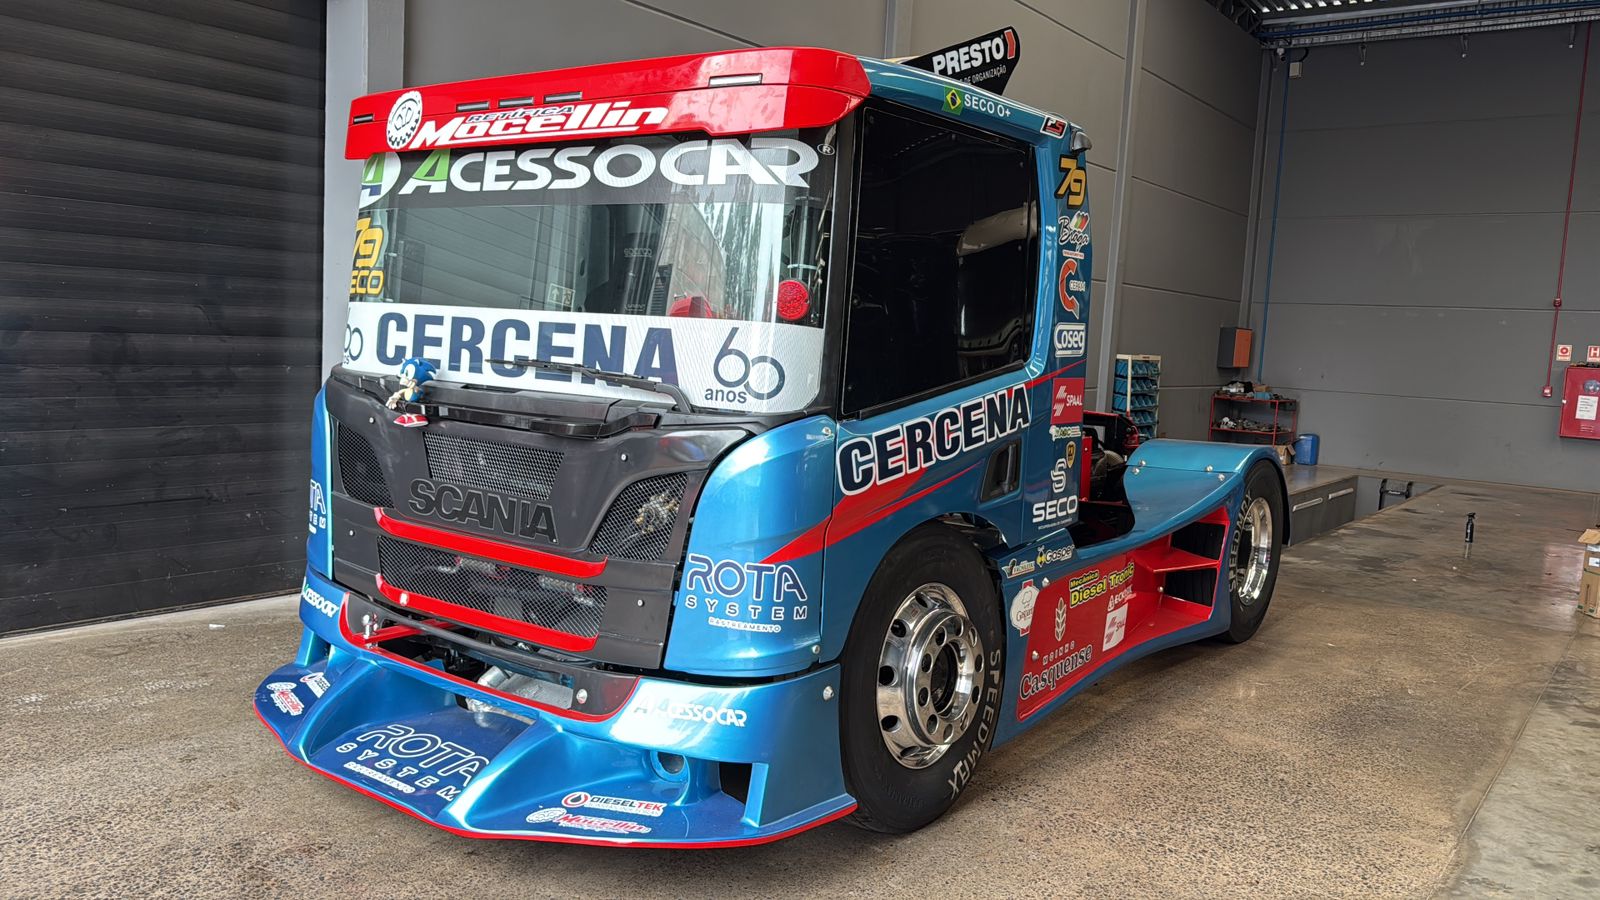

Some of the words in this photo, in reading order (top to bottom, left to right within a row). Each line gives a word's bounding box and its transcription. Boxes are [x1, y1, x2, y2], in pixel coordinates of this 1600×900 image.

[932, 37, 1005, 75] PRESTO
[408, 100, 670, 150] Mocellin
[467, 105, 576, 124] RETÍFICA
[964, 93, 995, 114] SECO
[397, 137, 819, 195] ACESSOCAR
[1054, 155, 1087, 209] 79
[375, 311, 680, 388] CERCENA
[713, 326, 785, 400] 60
[704, 387, 748, 404] anos
[836, 383, 1031, 496] CERCENA
[408, 478, 559, 545] SCANIA
[1032, 495, 1078, 523] SECO
[686, 553, 808, 602] ROTA
[1071, 576, 1107, 608] Diesel
[685, 595, 808, 621] SYSTEM
[1020, 644, 1092, 700] Casquense
[947, 649, 1002, 800] SPEEDMAX
[335, 742, 462, 802] SYSTEM
[356, 723, 490, 788] ROTA
[590, 796, 664, 811] DIESELTEK
